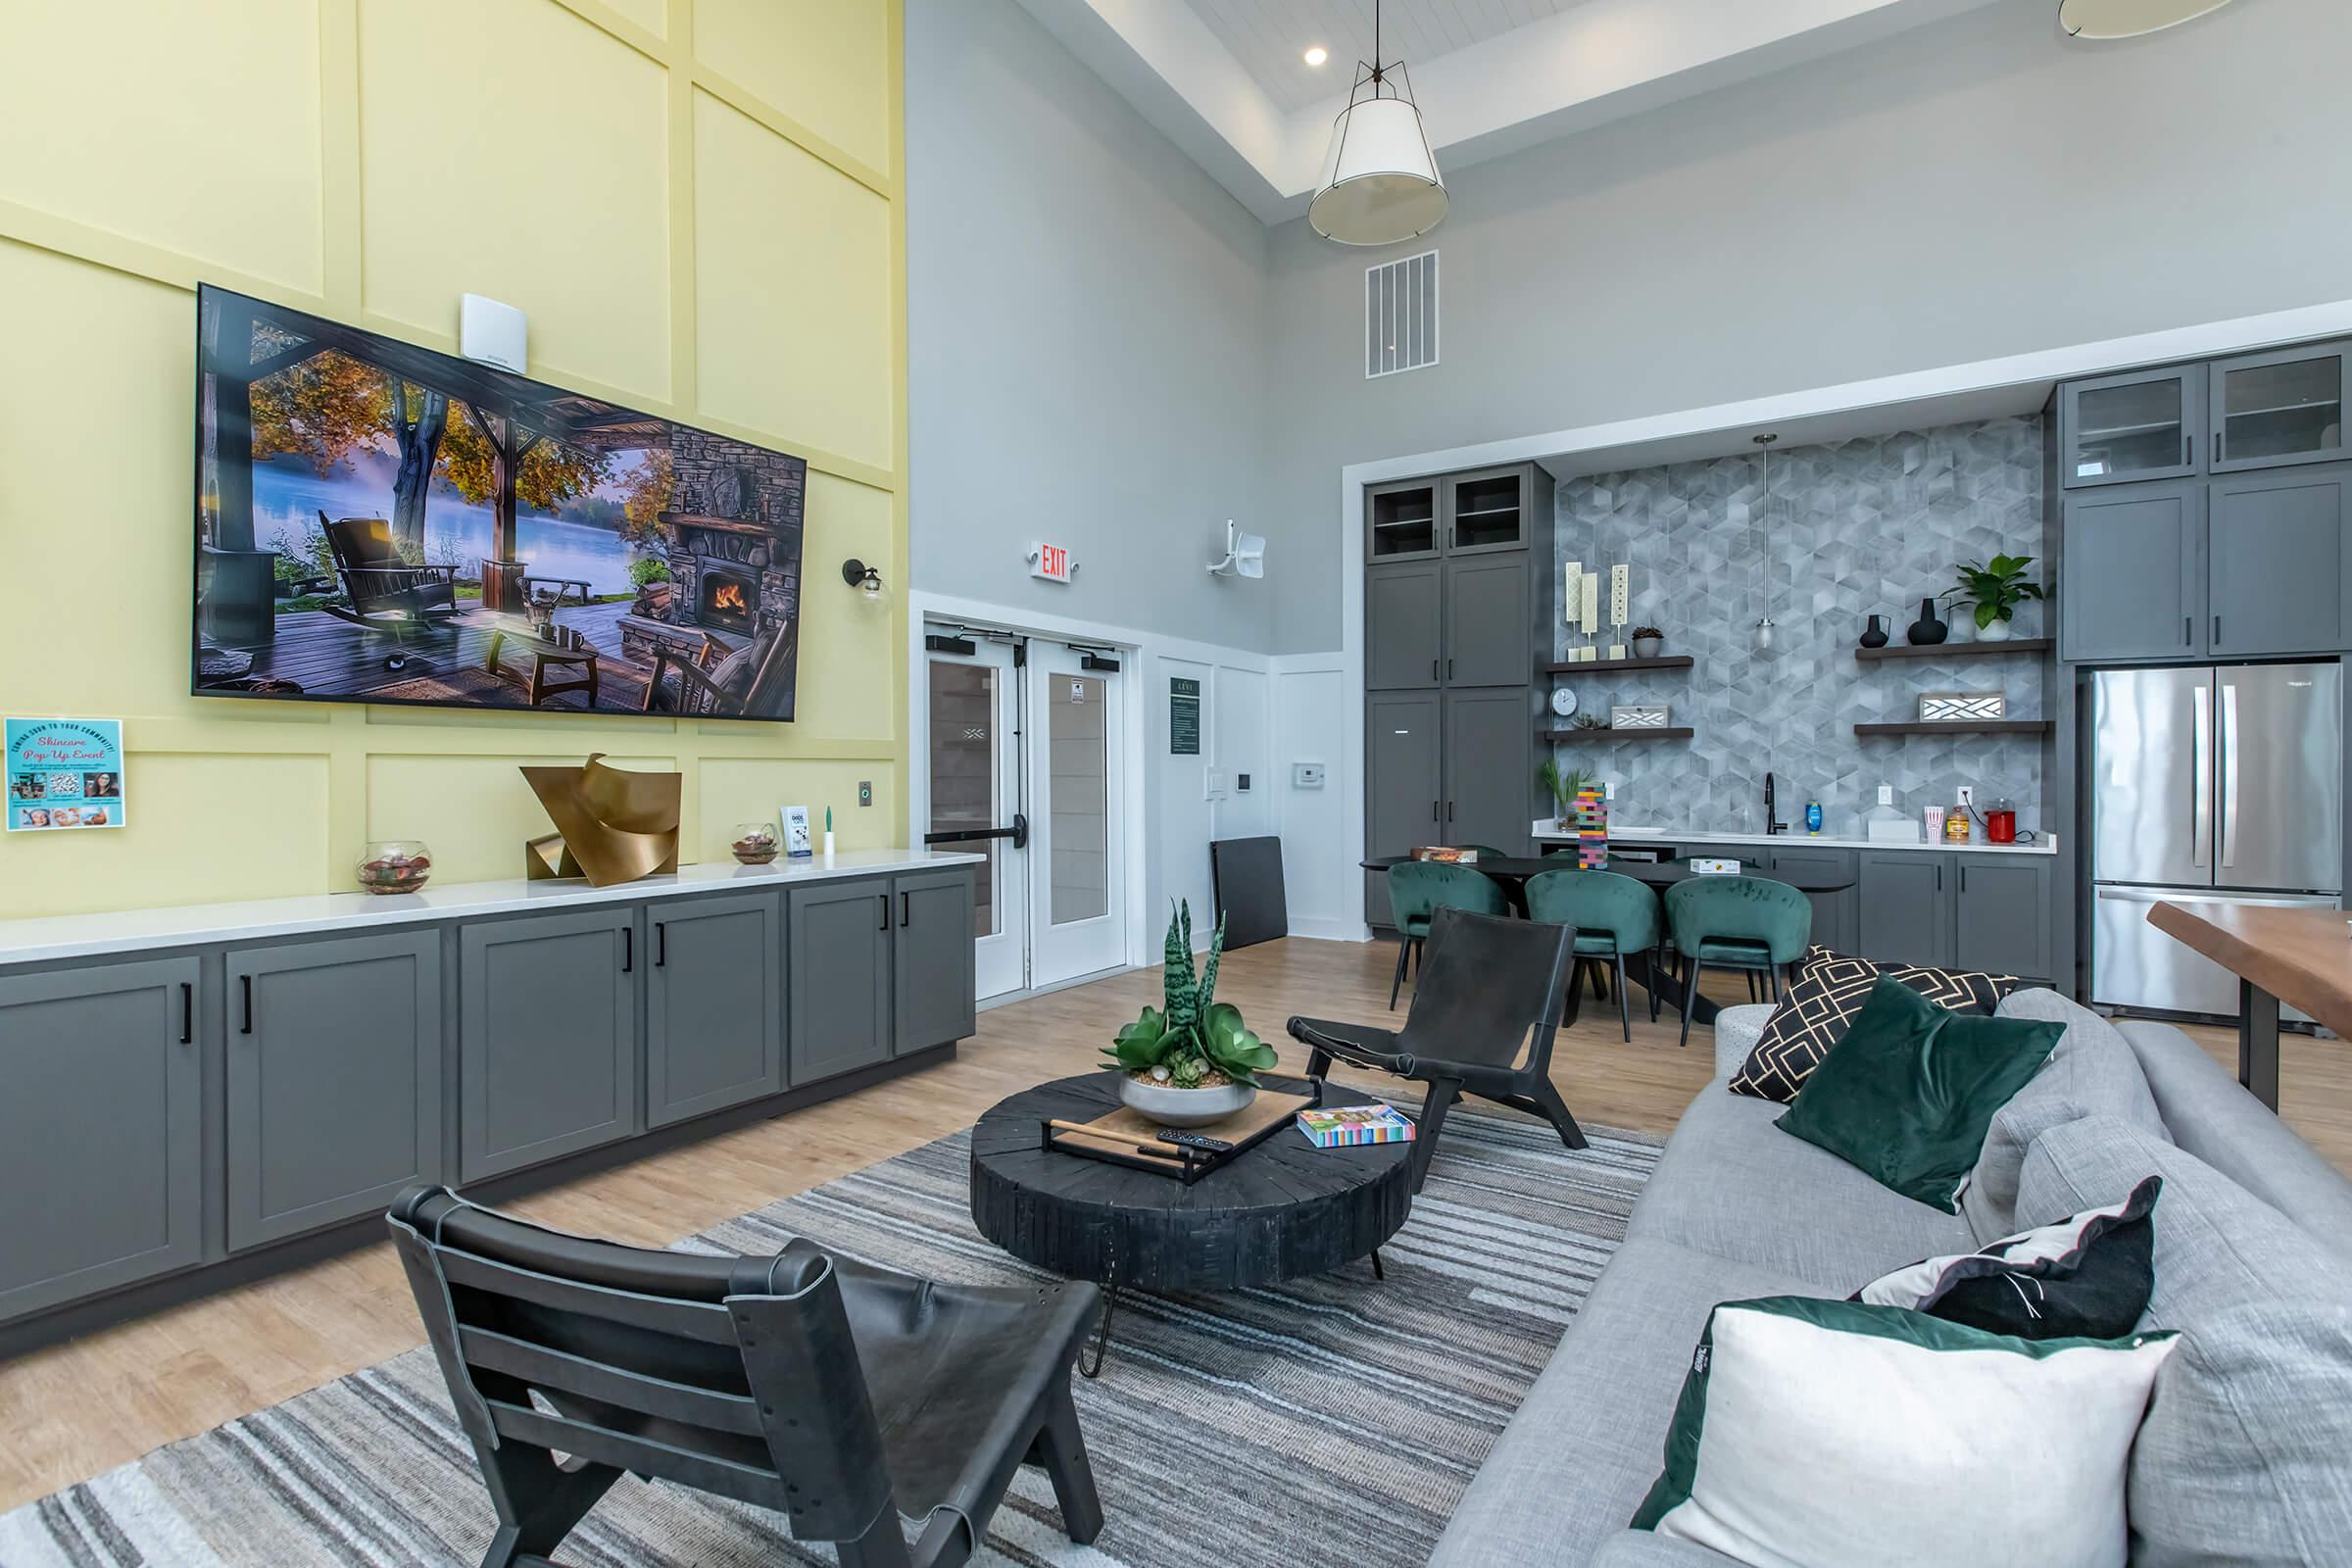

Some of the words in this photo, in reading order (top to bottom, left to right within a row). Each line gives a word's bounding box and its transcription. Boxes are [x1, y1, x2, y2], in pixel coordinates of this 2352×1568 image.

[1043, 543, 1066, 577] EXIT
[37, 736, 86, 746] Skincare
[73, 749, 105, 759] Event
